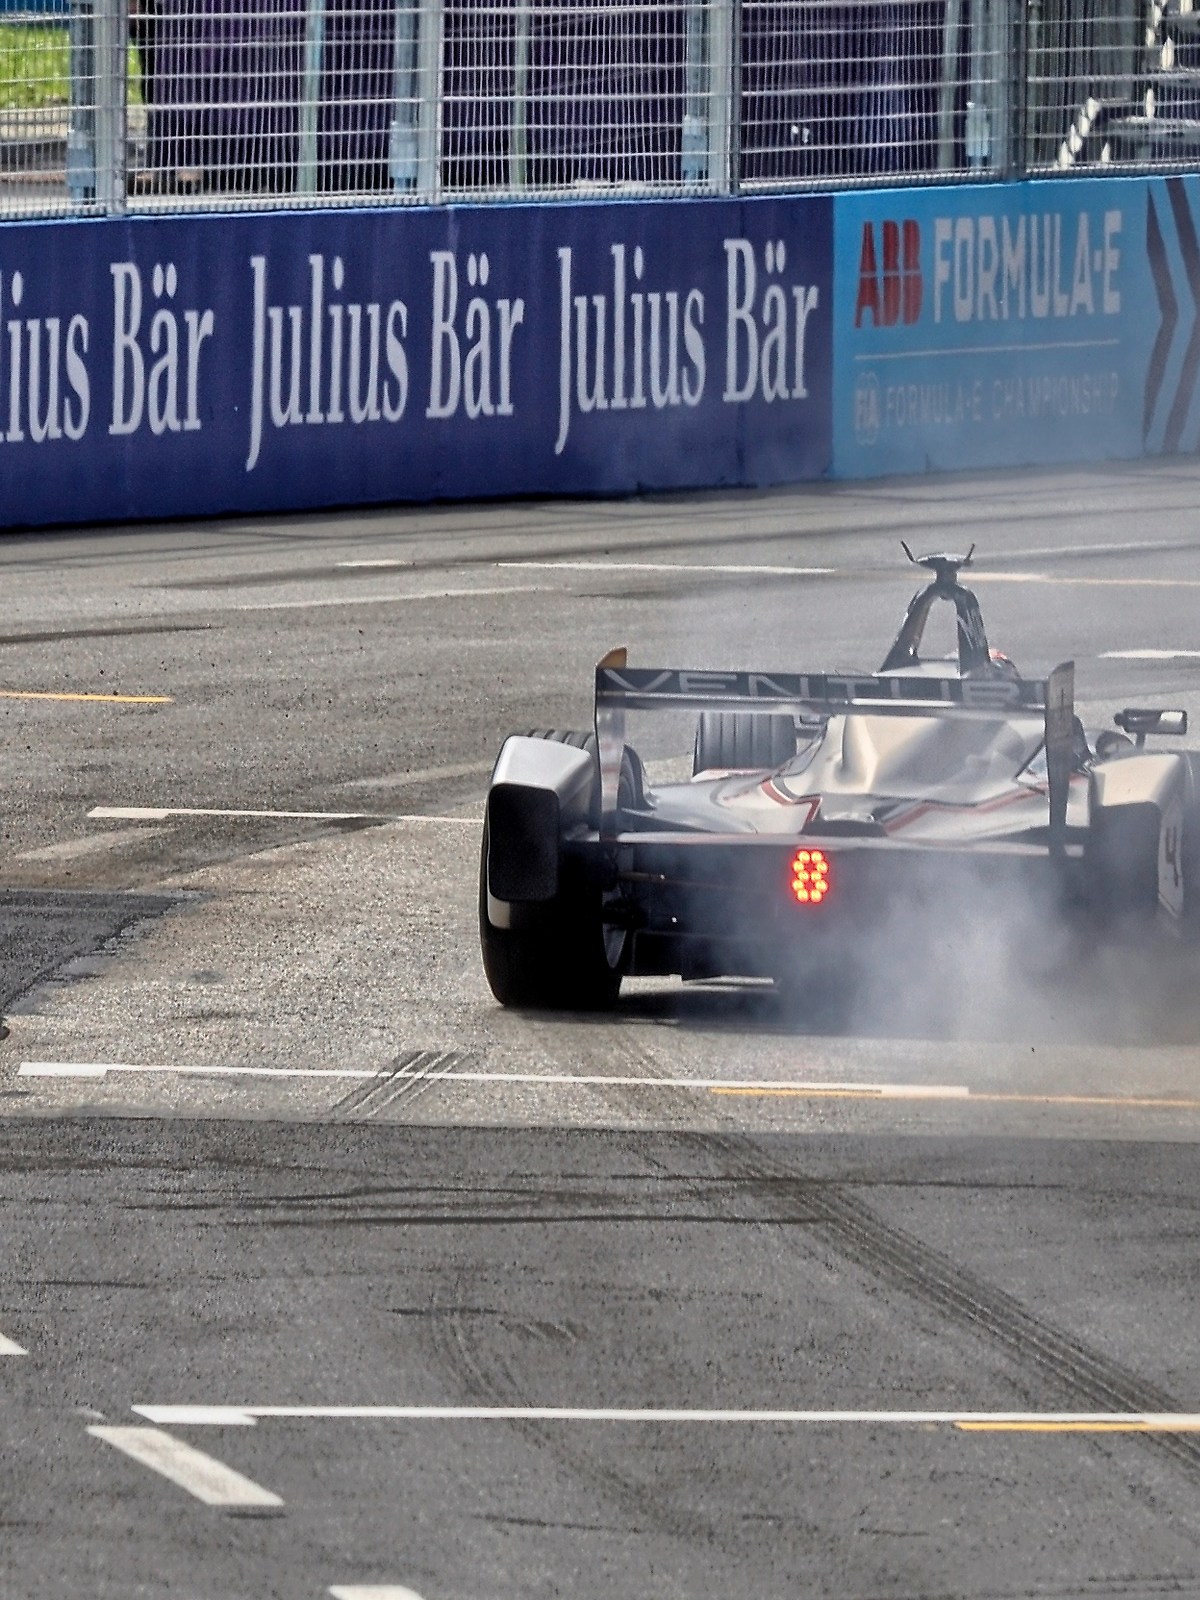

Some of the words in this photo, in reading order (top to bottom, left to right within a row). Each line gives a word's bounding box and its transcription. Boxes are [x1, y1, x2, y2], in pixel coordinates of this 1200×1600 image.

[0, 270, 90, 442] ius
[109, 262, 214, 435] Bär
[246, 254, 409, 472] Julius
[426, 250, 525, 420] Bär
[555, 243, 706, 455] Julius
[723, 238, 819, 403] Bär
[855, 219, 923, 328] ABB
